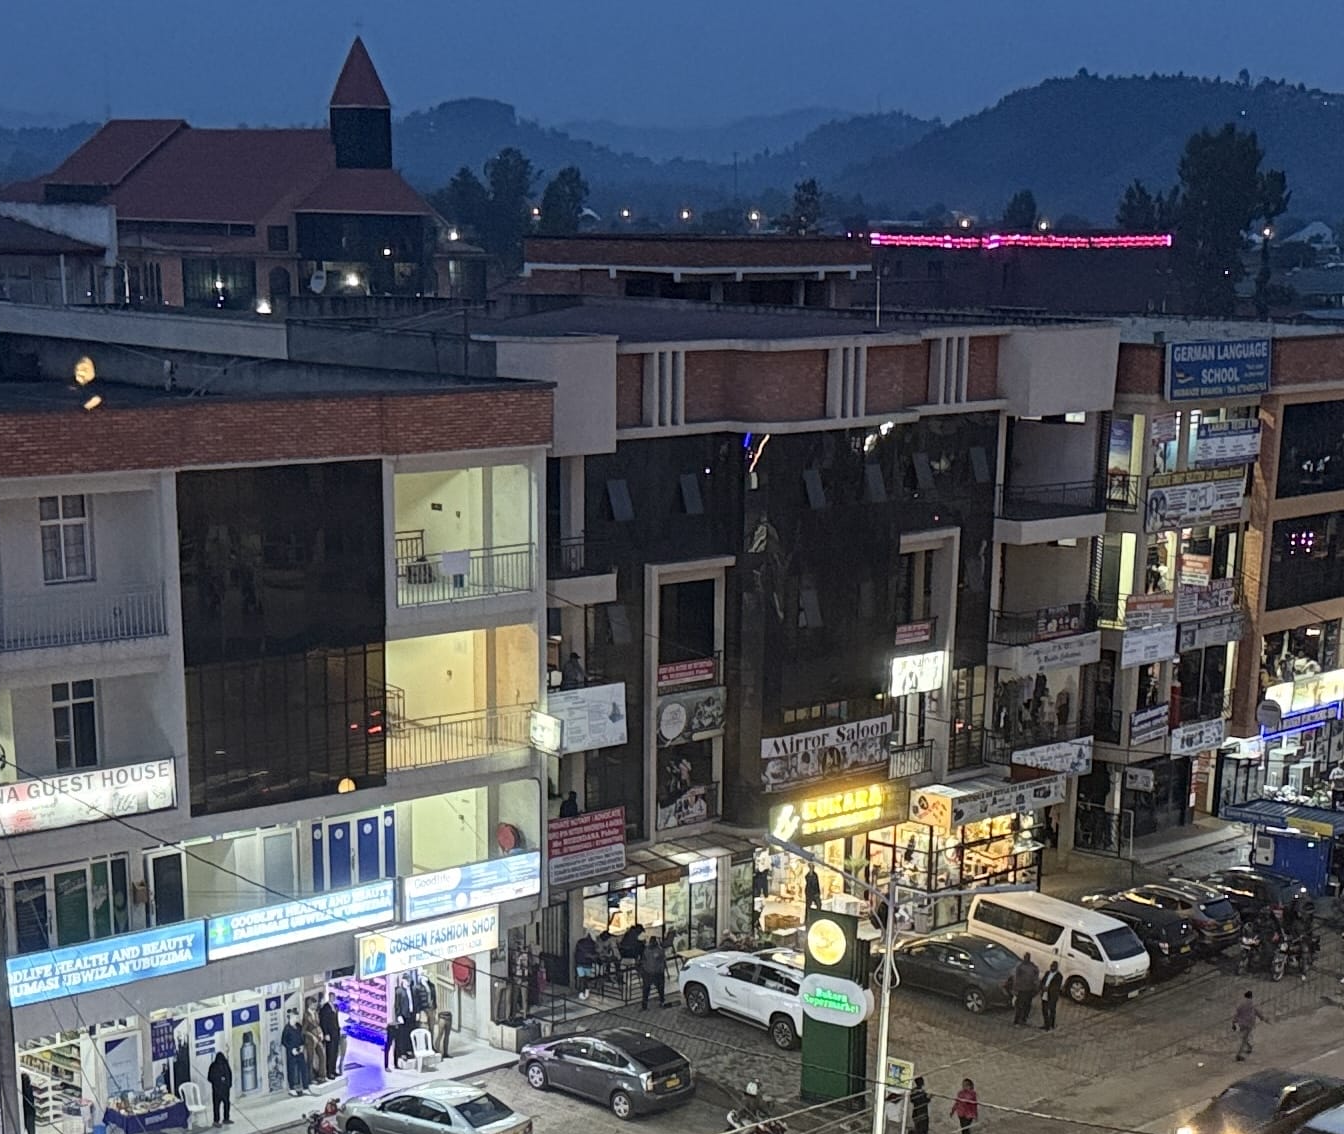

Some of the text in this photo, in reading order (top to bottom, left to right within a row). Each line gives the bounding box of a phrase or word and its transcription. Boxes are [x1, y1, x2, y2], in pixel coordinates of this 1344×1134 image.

[1173, 341, 1268, 362] GERMAN LANGUAGE
[1201, 367, 1240, 384] SCHOOL
[767, 721, 888, 757] Mirror Saloon
[27, 774, 95, 799] GUEST
[101, 764, 170, 788] HOUSE
[389, 931, 427, 955] GOSHEN
[430, 923, 469, 945] FASHION
[470, 915, 496, 936] SHOP
[56, 952, 111, 975] HEALTH
[111, 944, 141, 961] AND
[142, 934, 194, 956] BEAUTY
[803, 993, 860, 1014] Supermarket
